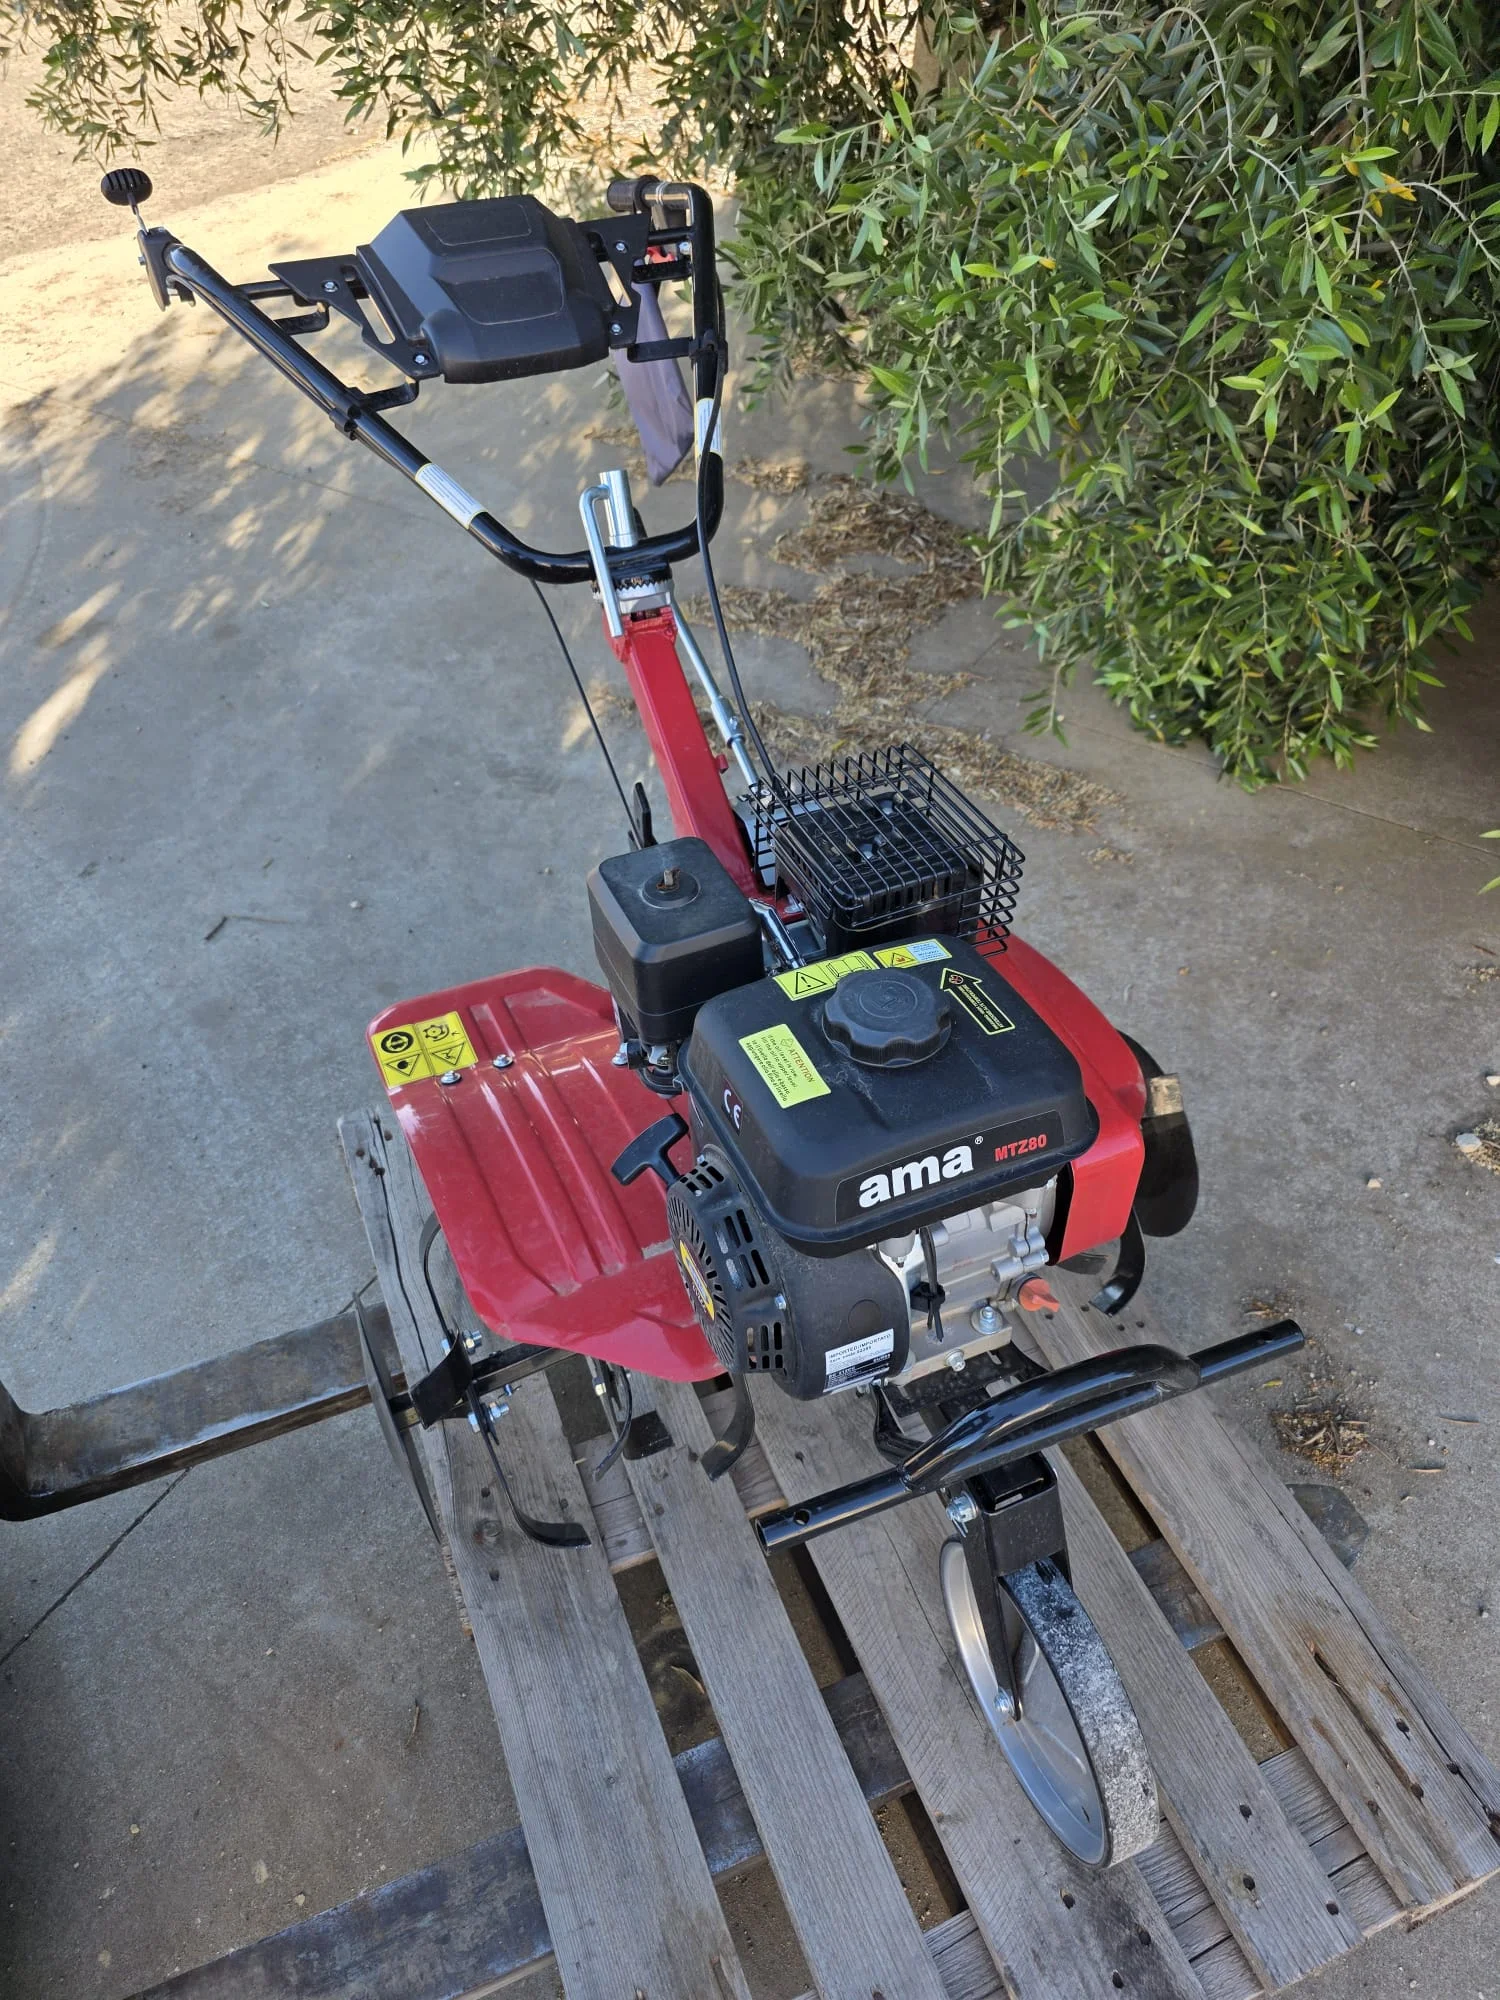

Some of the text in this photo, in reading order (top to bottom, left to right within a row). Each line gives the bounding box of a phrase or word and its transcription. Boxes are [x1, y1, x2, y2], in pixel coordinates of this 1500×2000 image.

[787, 1047, 816, 1082] ATTENTION
[724, 1089, 741, 1129] CE
[994, 1134, 1047, 1162] MTZ80
